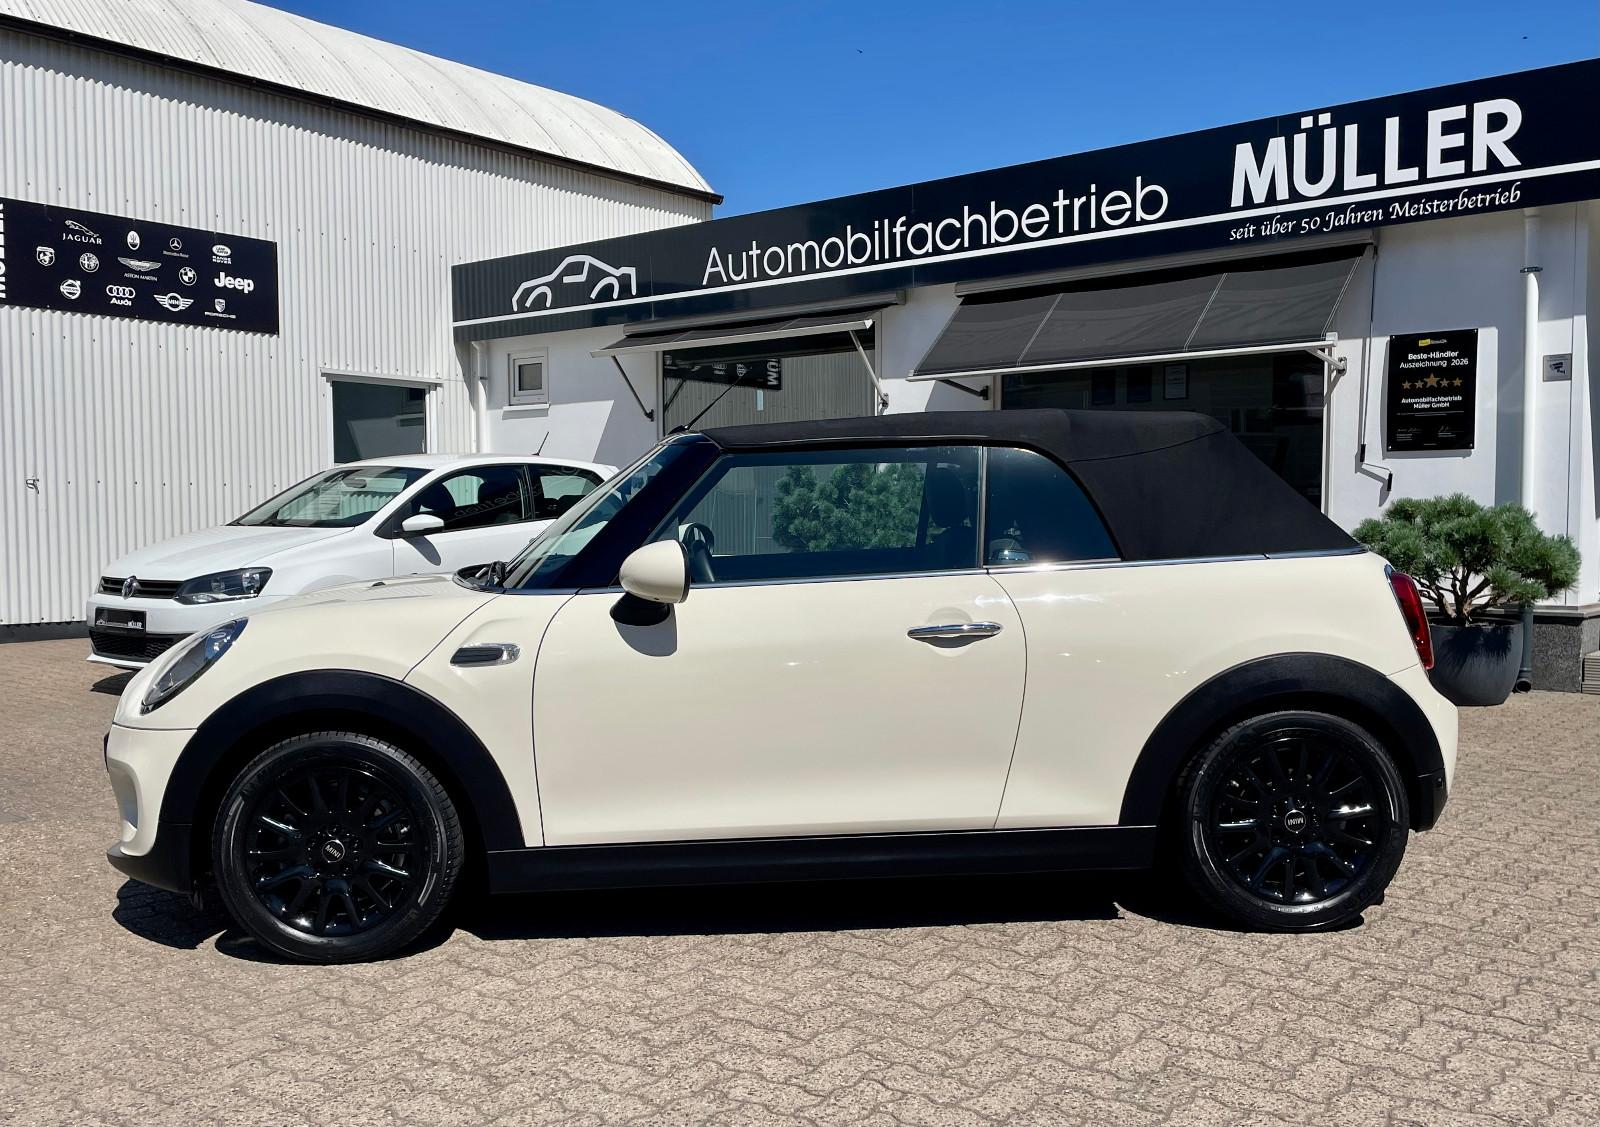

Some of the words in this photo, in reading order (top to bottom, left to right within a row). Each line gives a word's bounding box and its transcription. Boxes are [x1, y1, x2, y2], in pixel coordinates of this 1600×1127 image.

[1231, 98, 1522, 208] MÜLLER
[1229, 222, 1257, 241] seit
[1261, 215, 1296, 237] über
[1300, 216, 1321, 234] 50
[1323, 204, 1384, 232] Jahren
[1389, 181, 1521, 220] Meisterbetrieb
[62, 233, 103, 245] JAGUAR
[702, 175, 1168, 286] Automobilfachbetrieb
[214, 271, 255, 294] Jeep
[110, 298, 132, 306] Audi
[1399, 360, 1447, 368] Auszeichnung
[1451, 358, 1469, 366] 2026
[1408, 350, 1459, 360] Beste-Händler
